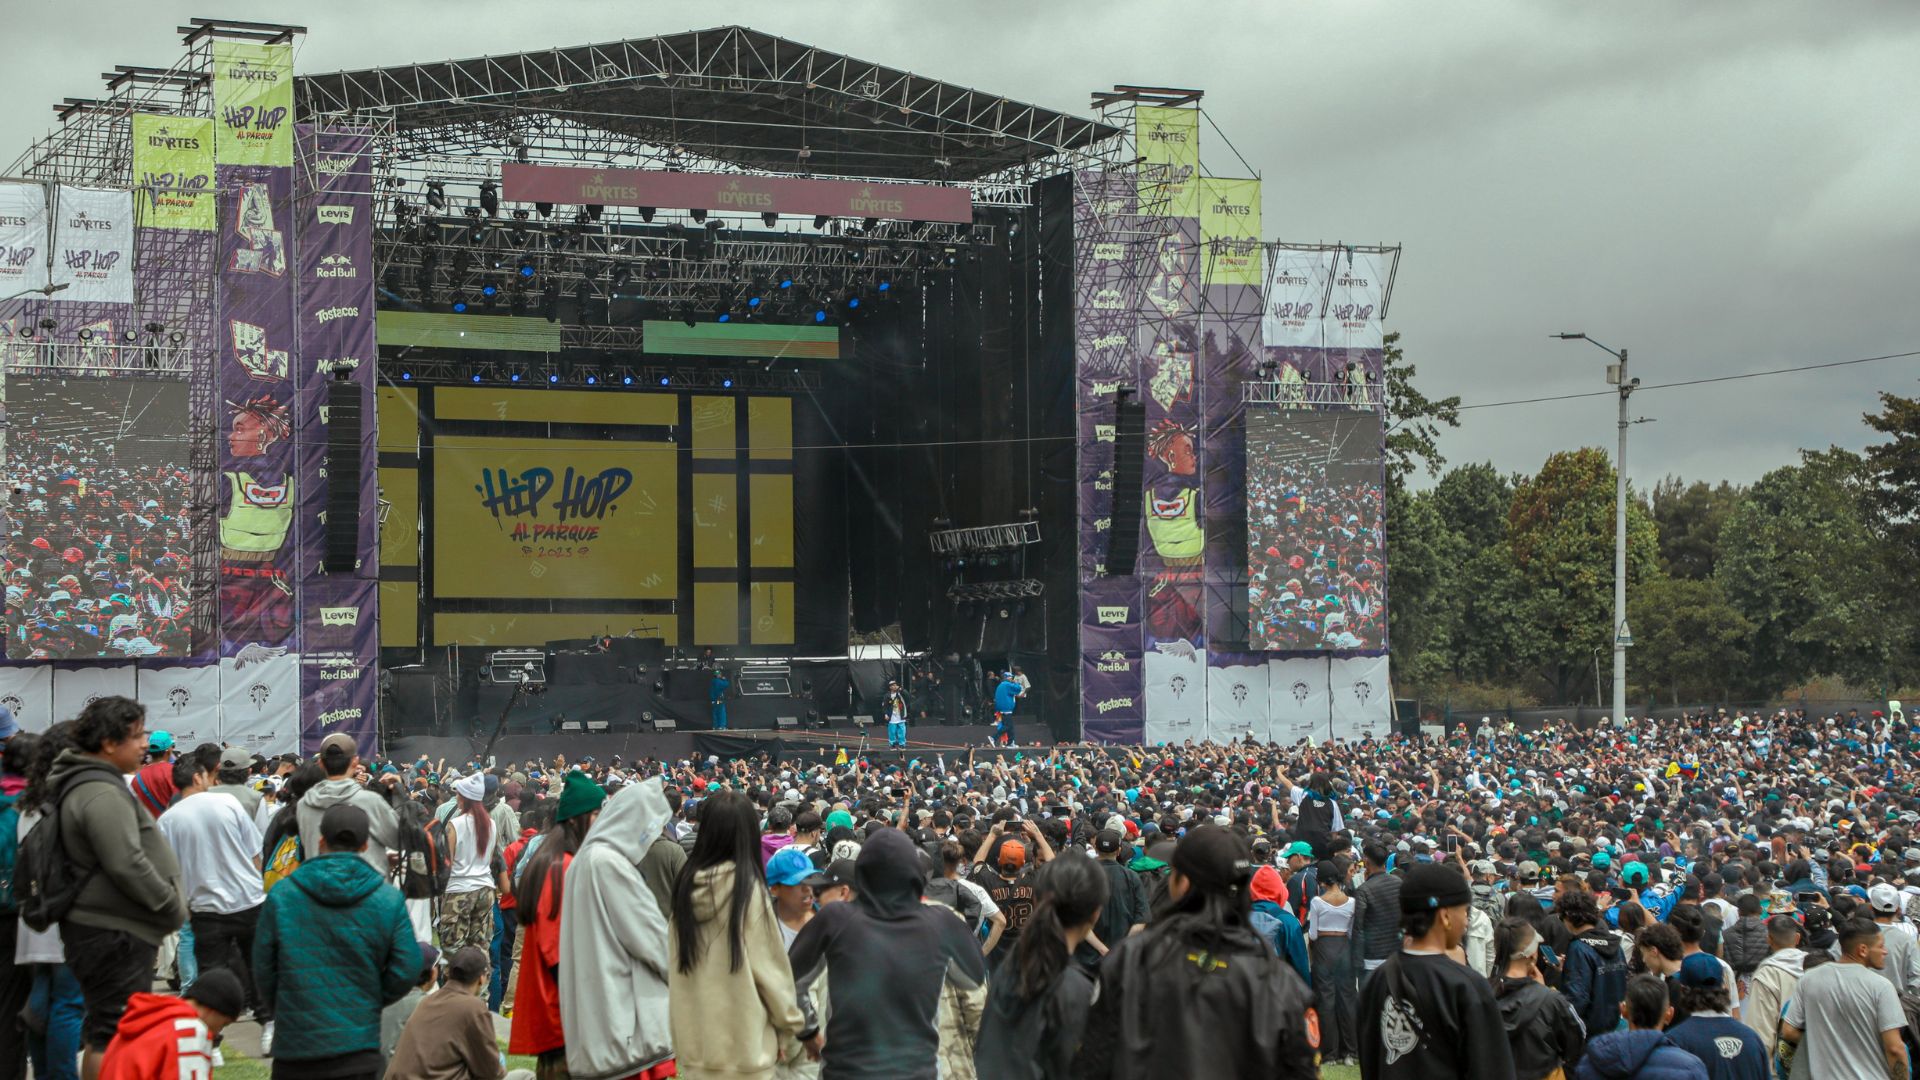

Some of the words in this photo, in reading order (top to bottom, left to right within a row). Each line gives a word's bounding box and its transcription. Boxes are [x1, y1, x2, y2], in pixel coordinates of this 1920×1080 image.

[229, 68, 278, 83] IDARTES
[148, 135, 200, 151] IDARTES
[1148, 131, 1187, 144] IDARTES
[581, 184, 639, 201] IDARTES
[717, 191, 773, 207] IDARTES
[850, 197, 903, 213] IDARTES
[1212, 204, 1250, 216] IDARTES
[0, 215, 26, 228] RTES
[69, 218, 112, 231] IDARTES
[316, 267, 336, 278] Red
[337, 267, 356, 278] Bull
[1276, 276, 1308, 286] IDARTES
[1337, 277, 1368, 287] IDARTES
[1093, 299, 1109, 309] Red
[1109, 300, 1125, 309] Bull
[315, 306, 359, 324] Tostacos
[1092, 335, 1128, 351] Tostacos
[1095, 480, 1112, 490] Red
[510, 522, 531, 541] AL
[532, 523, 601, 543] PARQUE
[538, 546, 574, 558] 2023
[1097, 662, 1114, 672] Red
[1114, 662, 1130, 672] Bull
[320, 669, 340, 680] Red
[340, 669, 360, 680] Bull
[1096, 697, 1132, 715] Tostacos
[318, 707, 362, 728] Tostacos
